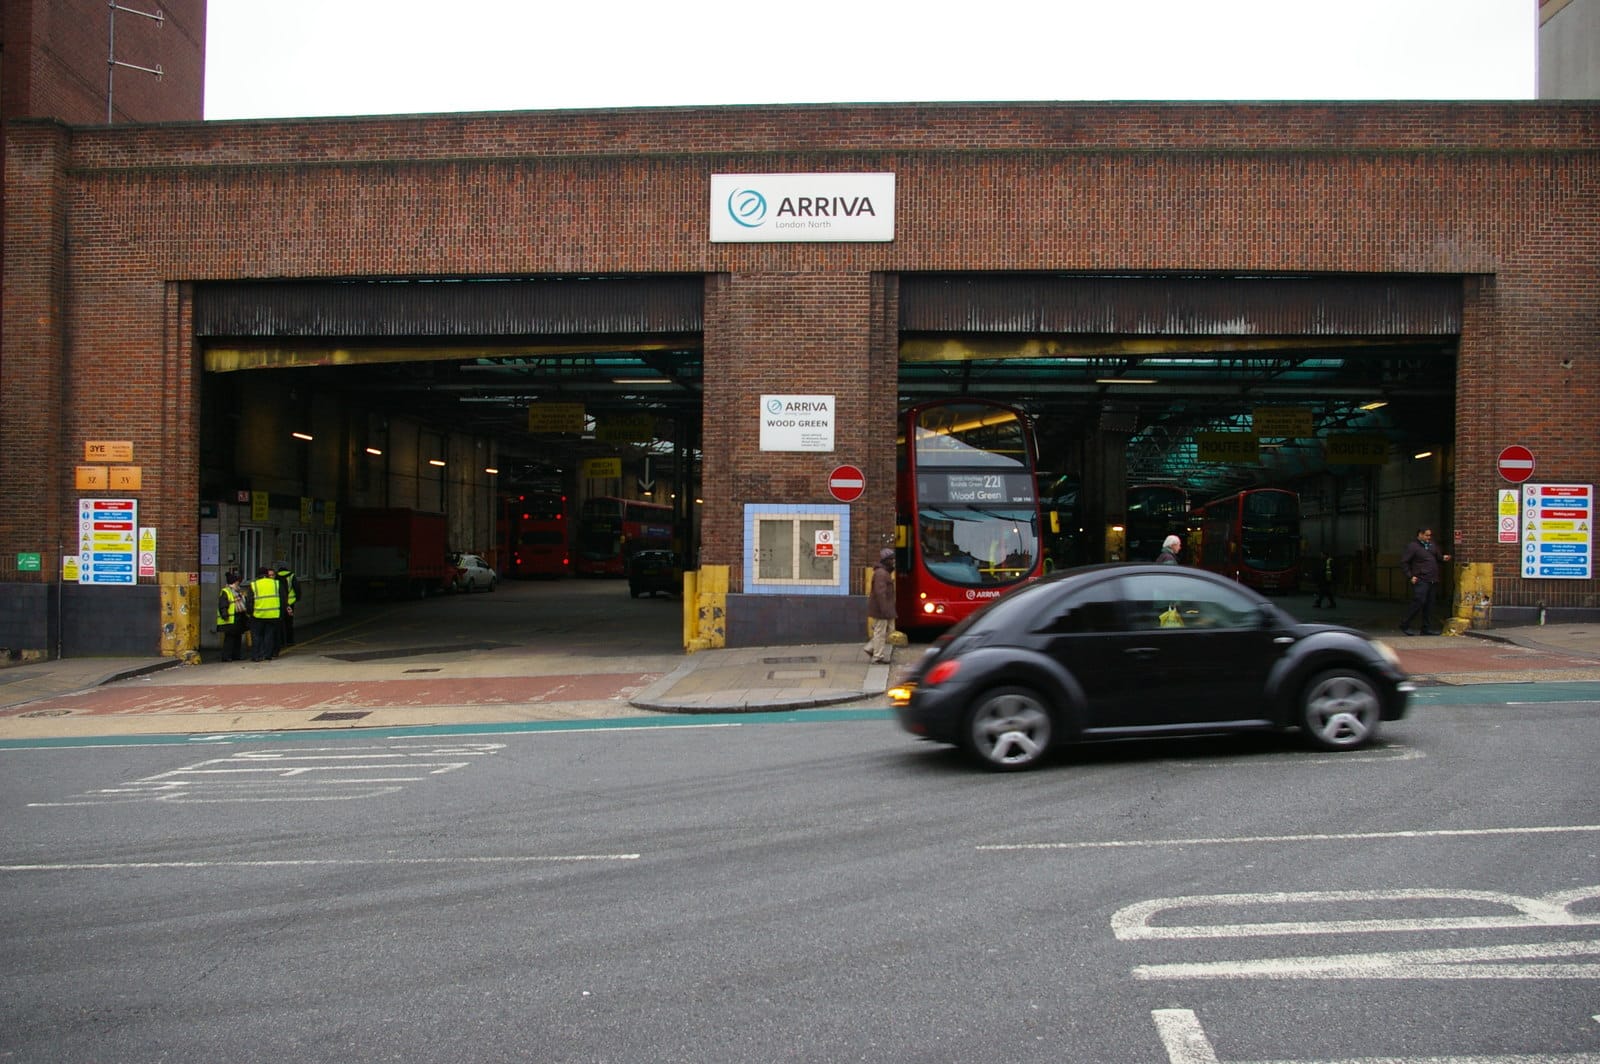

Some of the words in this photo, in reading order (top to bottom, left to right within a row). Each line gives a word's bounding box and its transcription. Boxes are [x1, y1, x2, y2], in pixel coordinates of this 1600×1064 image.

[777, 197, 876, 217] ARRIVA
[776, 220, 806, 229] London
[808, 220, 832, 229] North
[785, 402, 828, 411] ARRIVA
[767, 420, 796, 428] WOOD
[798, 420, 828, 428] GREEN
[89, 445, 105, 453] 3YE
[1202, 440, 1241, 453] ROUTE
[984, 475, 1001, 488] 221
[951, 491, 975, 500] Wood
[976, 490, 1002, 500] Green
[976, 590, 1000, 598] ARRIVA
